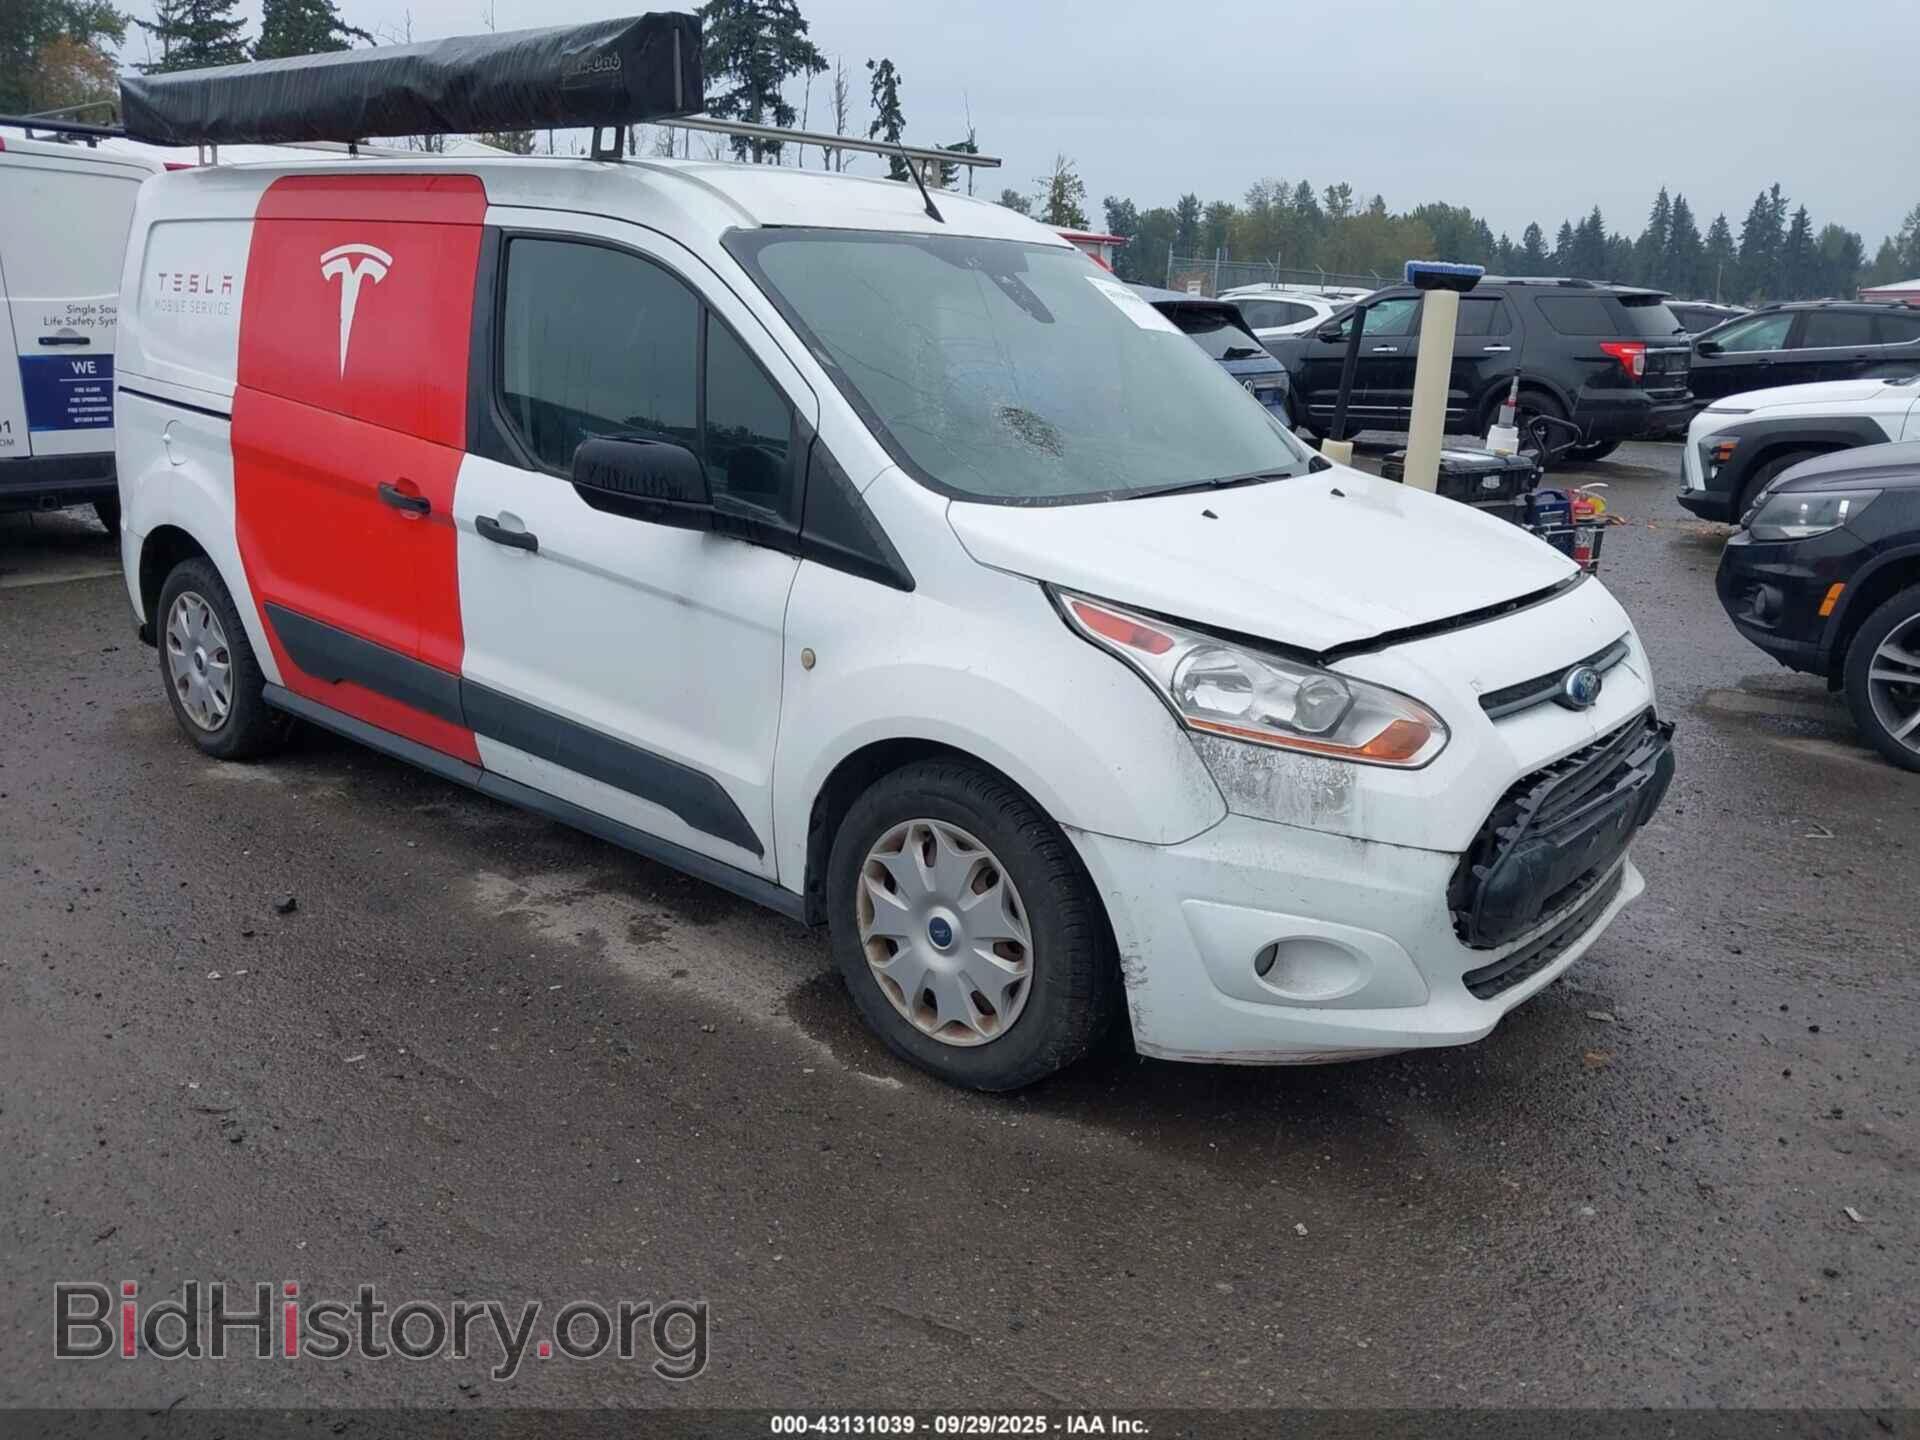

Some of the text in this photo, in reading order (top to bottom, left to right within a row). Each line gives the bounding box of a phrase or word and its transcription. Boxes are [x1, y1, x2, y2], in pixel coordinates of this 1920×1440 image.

[158, 273, 232, 296] TESLA
[66, 304, 96, 317] Single
[190, 299, 232, 316] SERVICE
[43, 316, 63, 326] Life
[65, 316, 96, 328] Safety
[72, 361, 97, 374] WE
